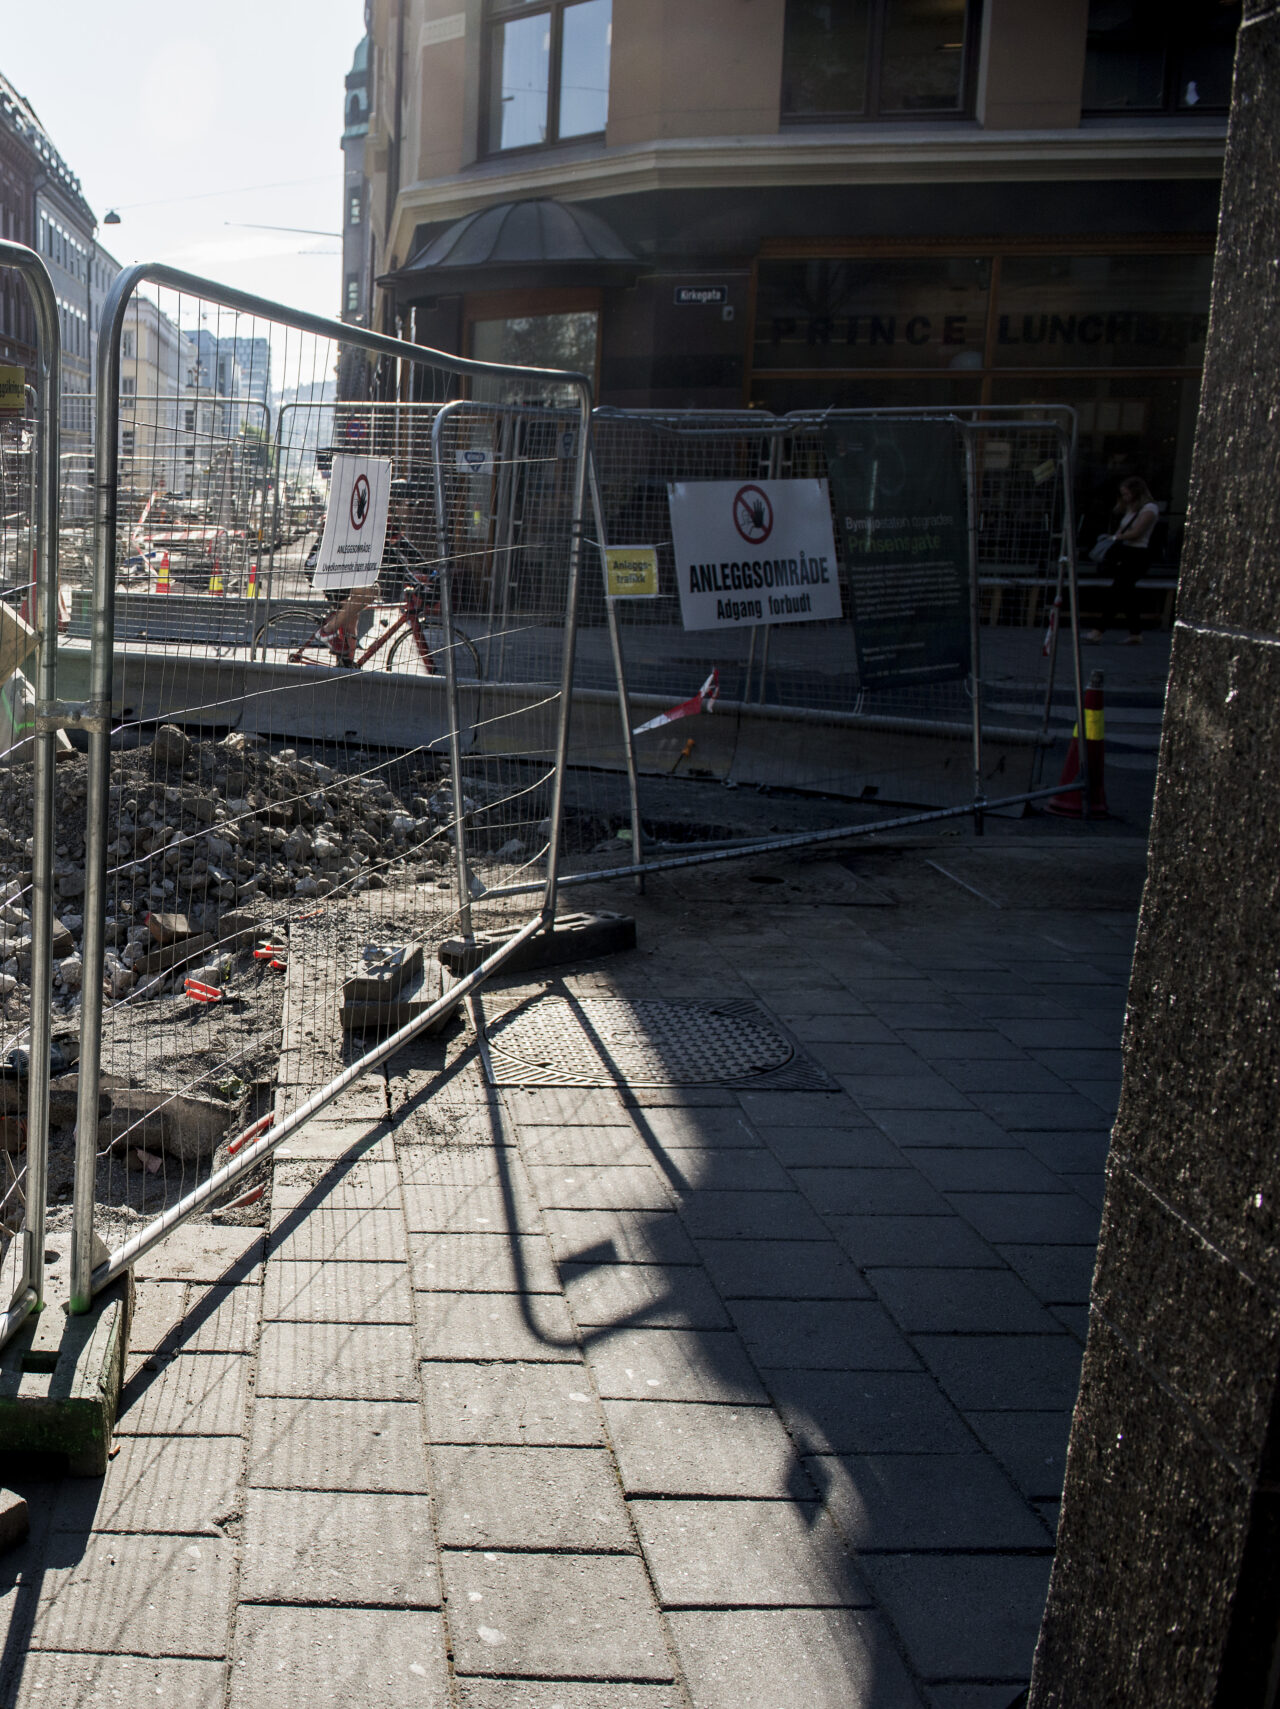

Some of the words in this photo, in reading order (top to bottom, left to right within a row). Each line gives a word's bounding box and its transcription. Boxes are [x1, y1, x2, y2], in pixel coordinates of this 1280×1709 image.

[681, 289, 721, 304] Kirkegata
[772, 315, 967, 345] PRINCE
[337, 541, 372, 554] ANLEGGSOMRÅDE
[911, 533, 942, 554] gate
[613, 560, 652, 572] Anleggs-
[689, 550, 830, 593] ANLEGGSOMRÅDE
[616, 573, 646, 584] trafikk
[717, 598, 763, 621] Adgang
[768, 592, 812, 616] forbudt
